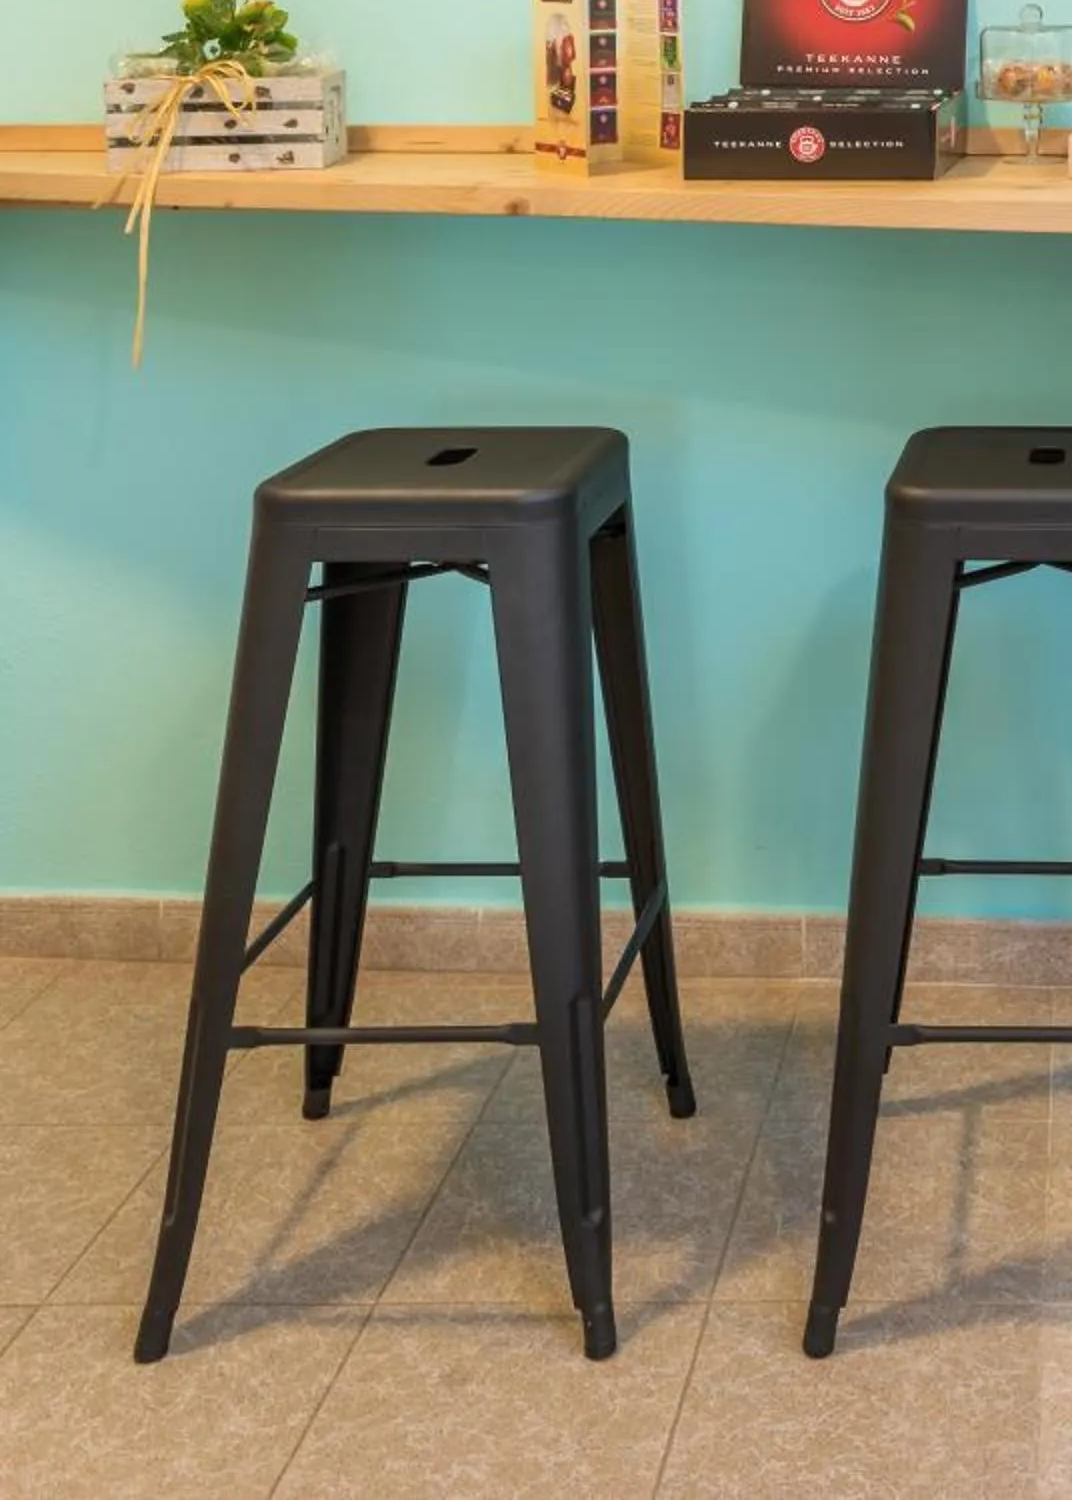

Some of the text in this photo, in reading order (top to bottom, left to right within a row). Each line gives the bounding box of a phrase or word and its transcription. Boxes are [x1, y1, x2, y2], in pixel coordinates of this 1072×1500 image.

[805, 52, 902, 65] TEEKANNE
[776, 64, 930, 76] PREMIUM SELECTION
[713, 140, 905, 149] TEEKANNE SELECTION
